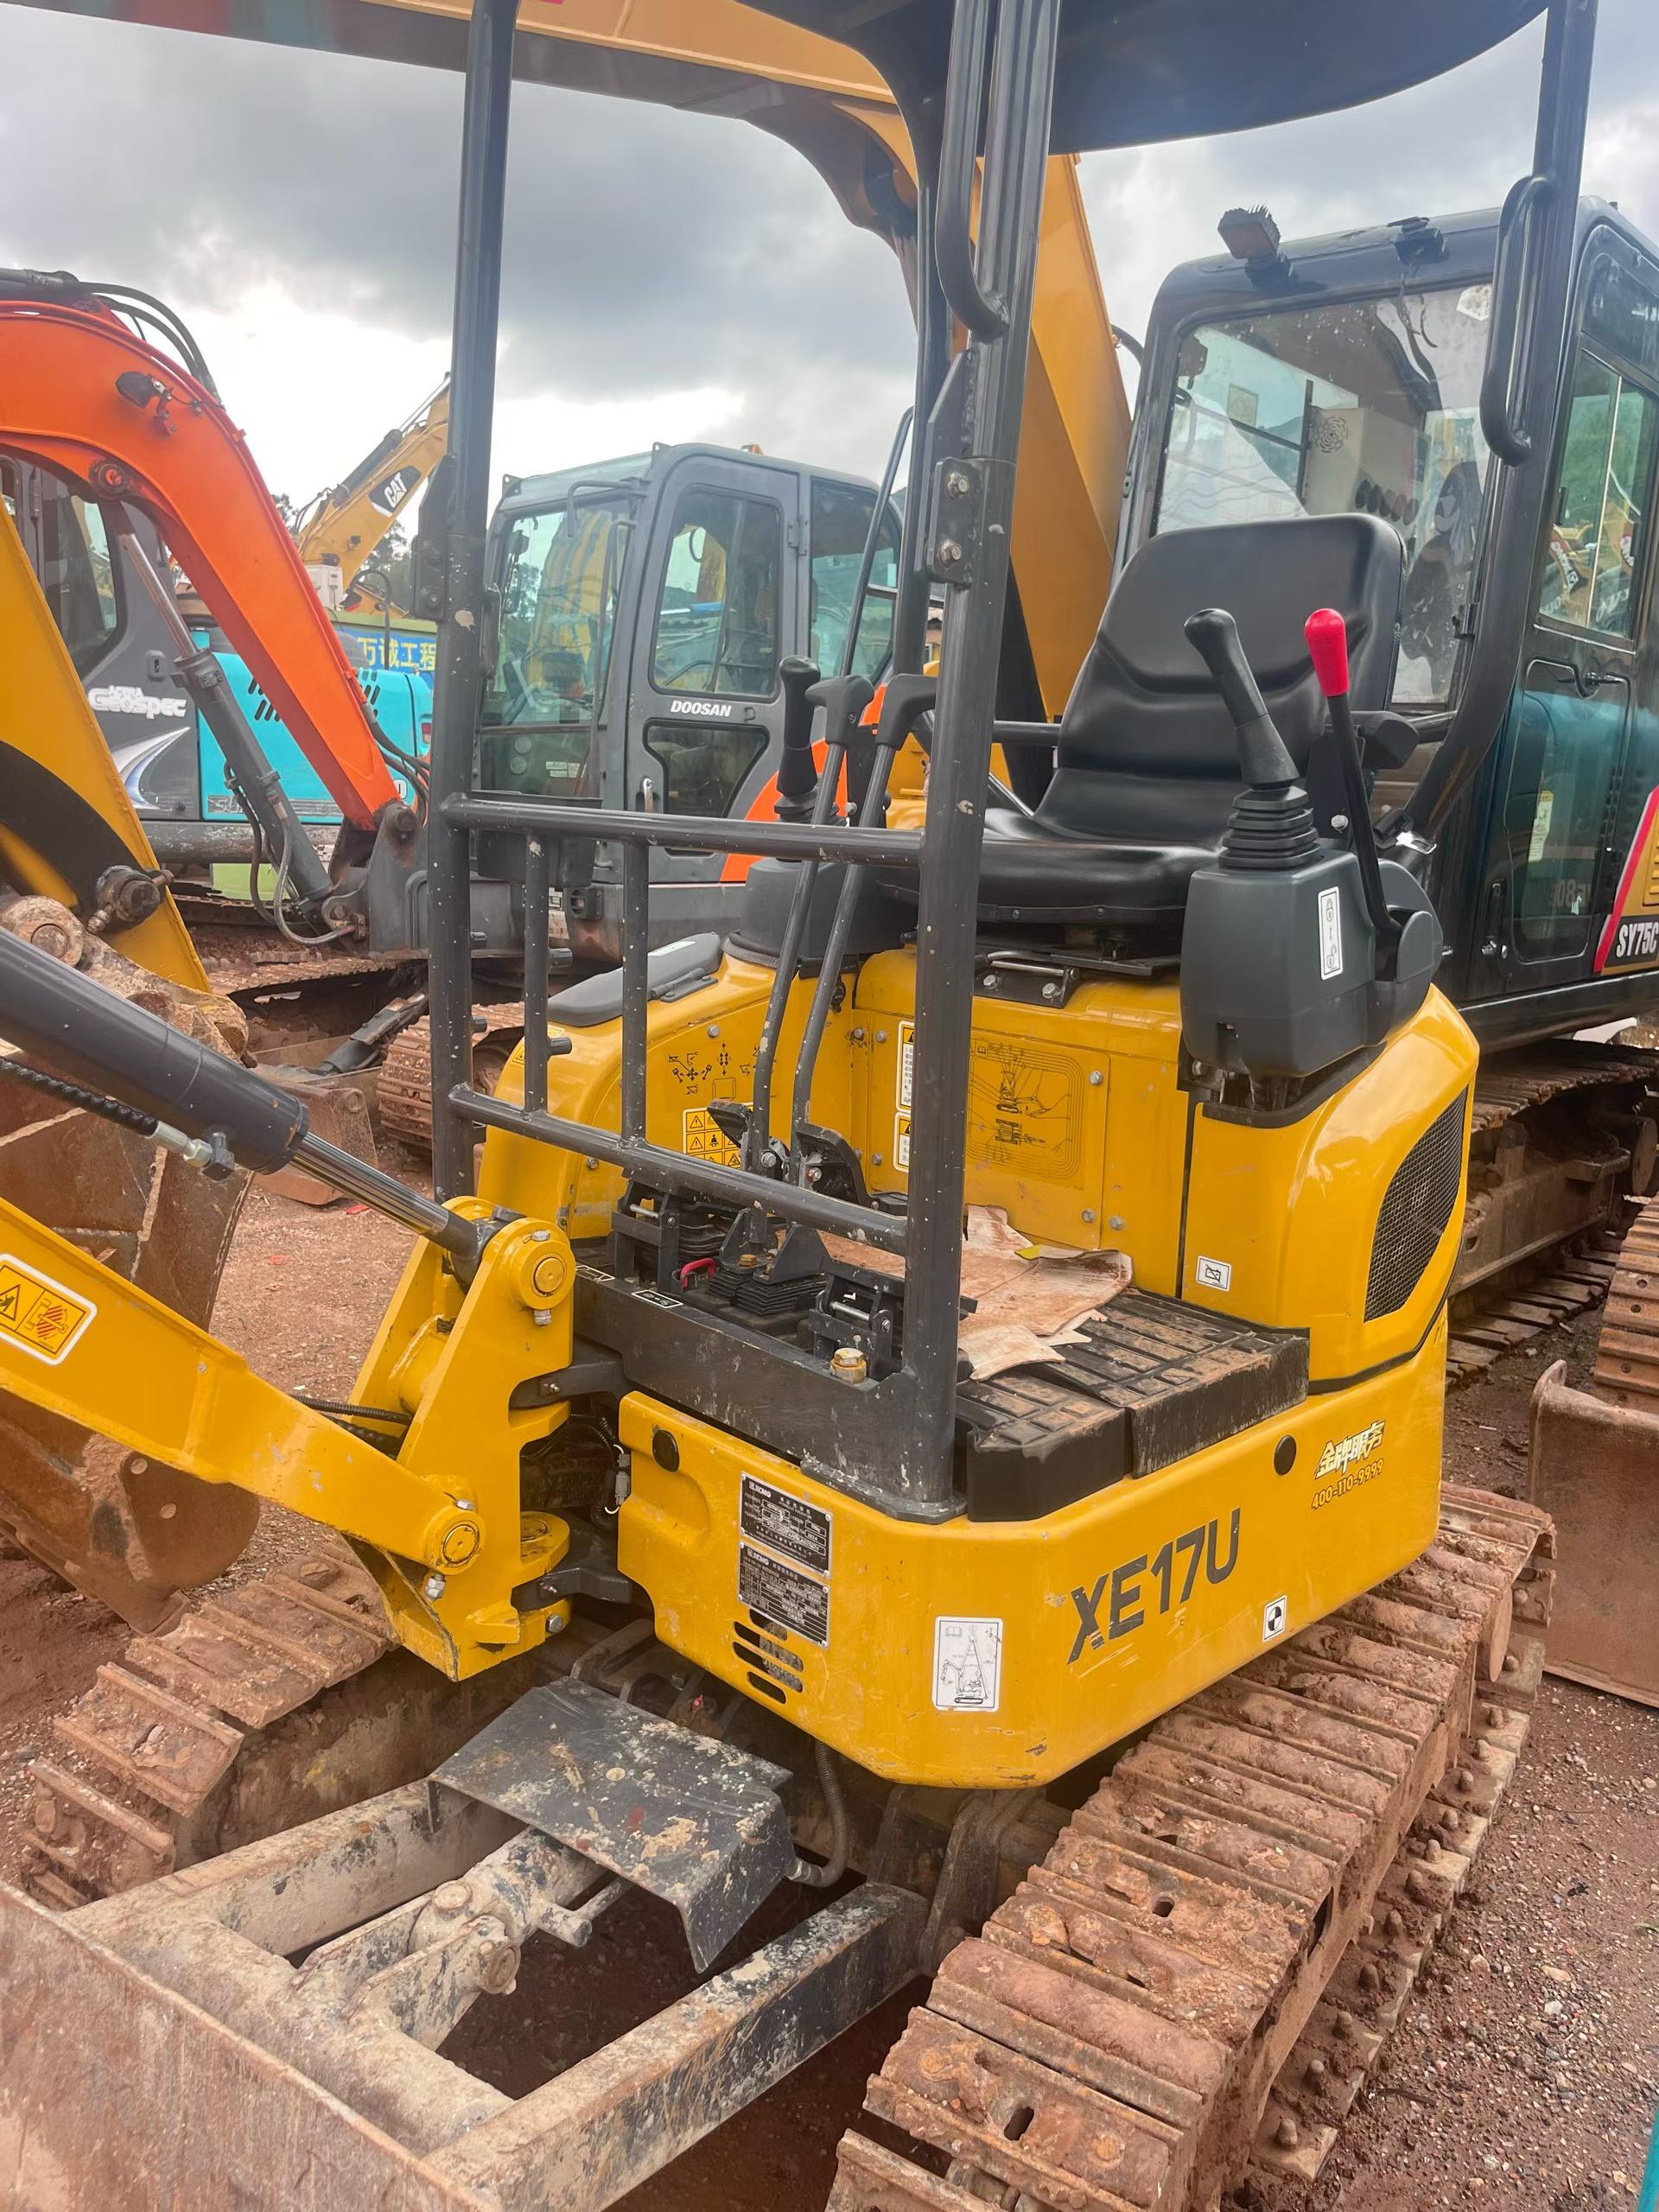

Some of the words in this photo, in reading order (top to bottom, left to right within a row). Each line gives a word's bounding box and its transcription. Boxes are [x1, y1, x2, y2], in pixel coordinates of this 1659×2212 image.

[384, 472, 407, 509] CAT
[671, 700, 732, 717] DOOSAN
[1616, 921, 1659, 957] SY75C
[1314, 1420, 1386, 1480] 金牌服务
[1312, 1458, 1384, 1510] 400-110-9999
[1066, 1507, 1242, 1665] XE17U
